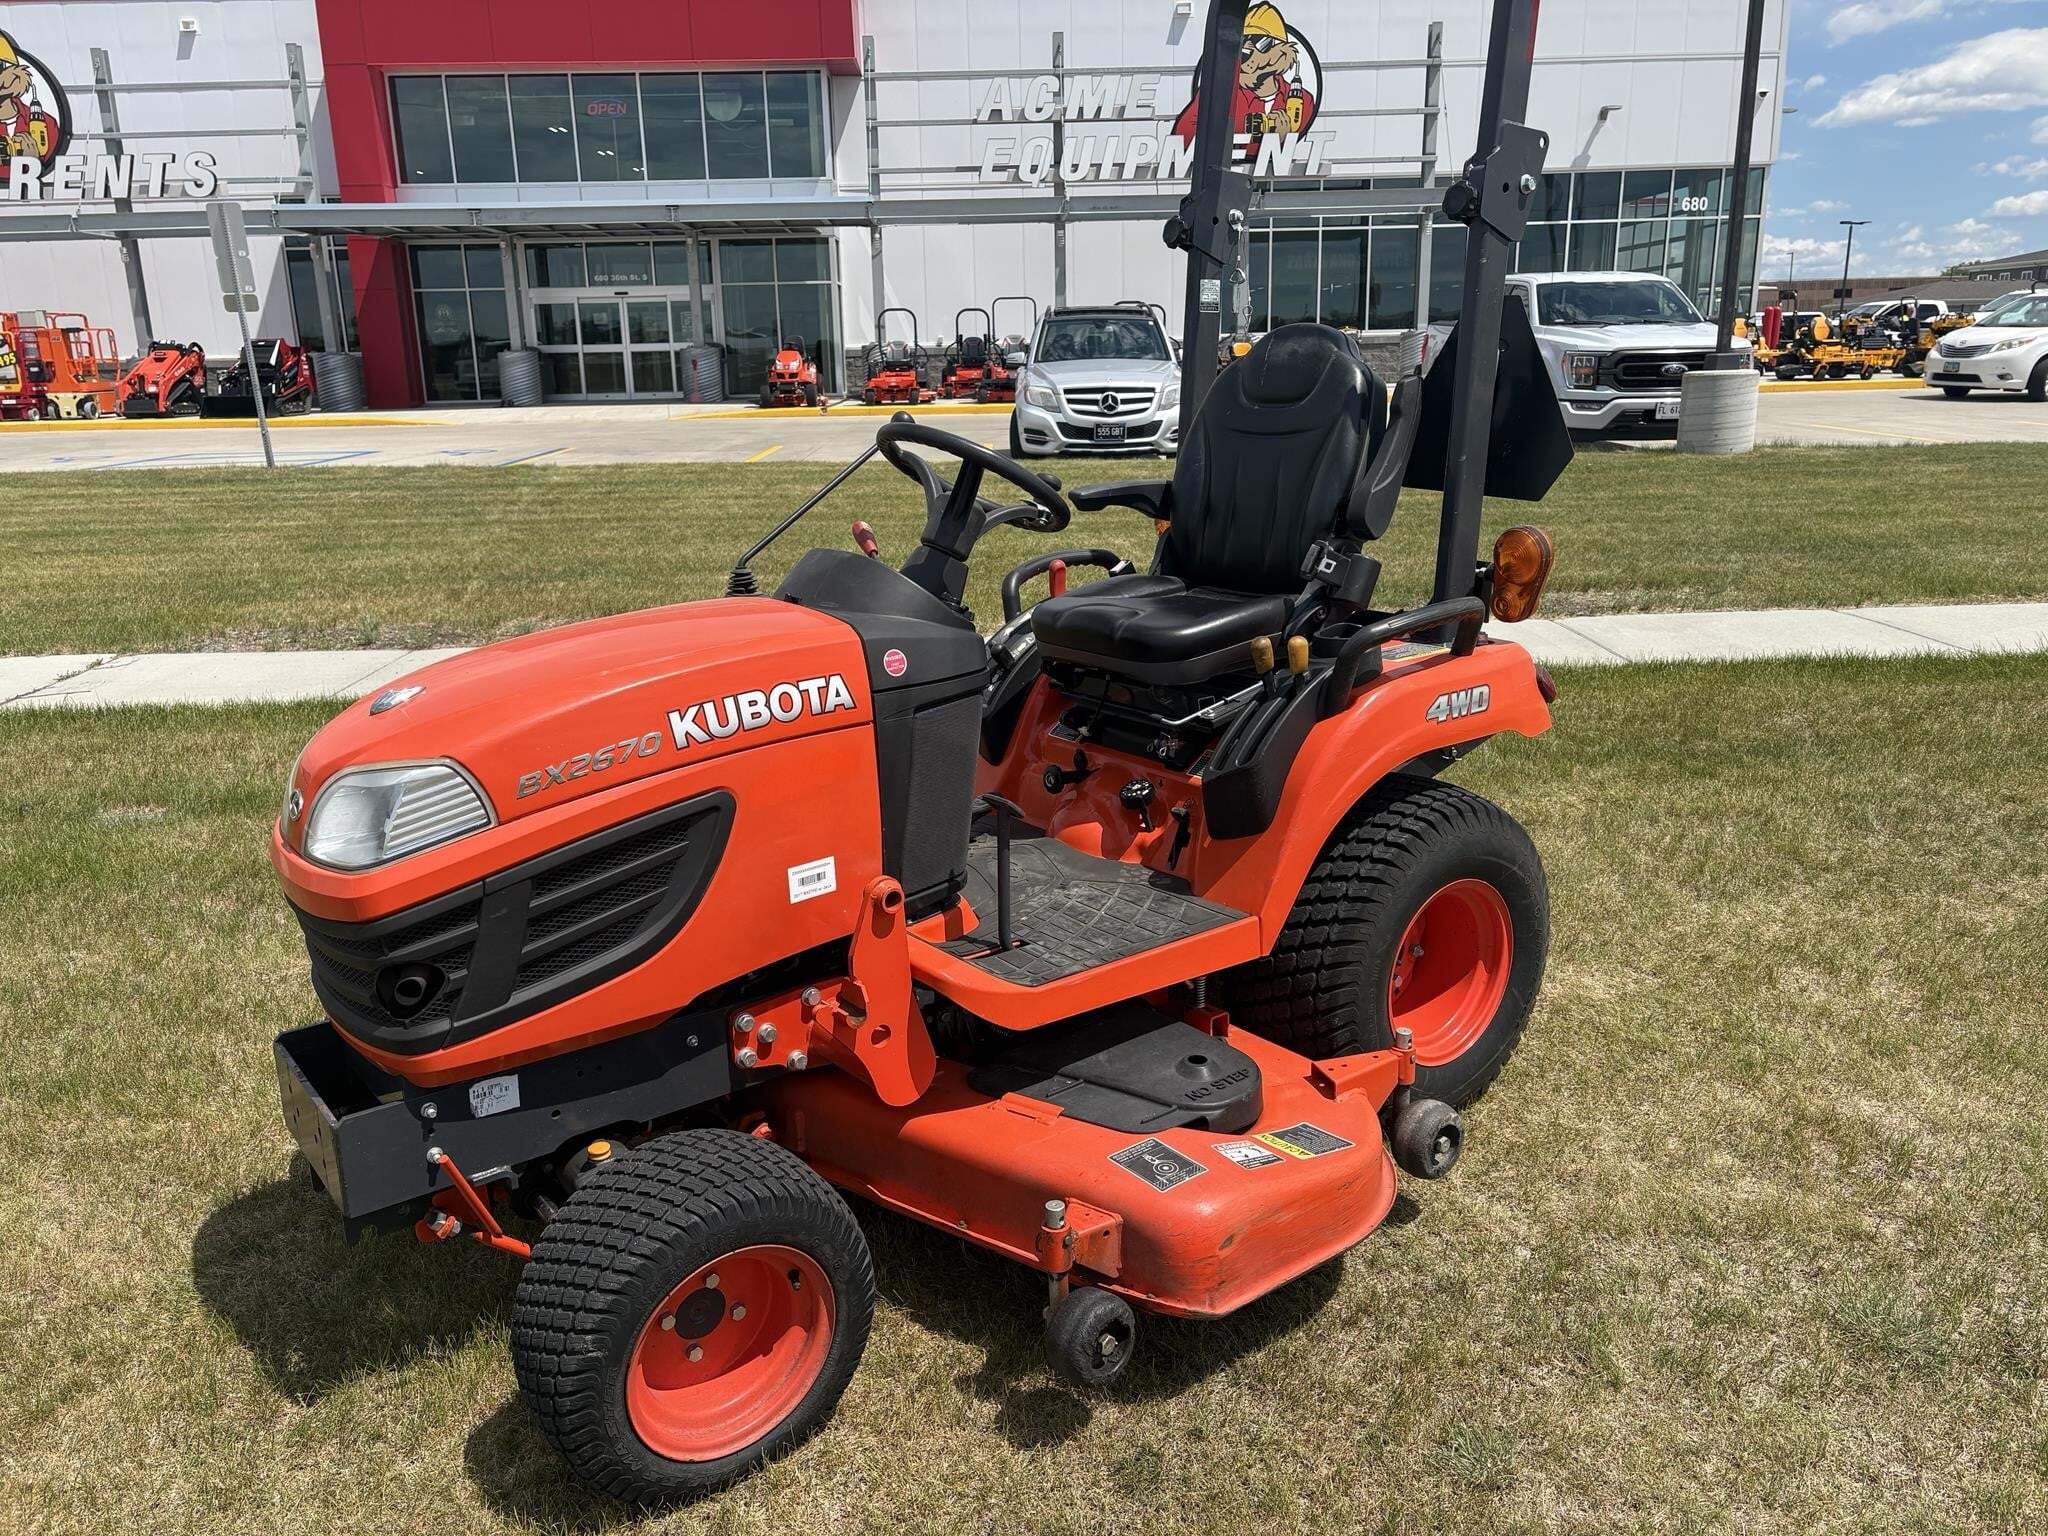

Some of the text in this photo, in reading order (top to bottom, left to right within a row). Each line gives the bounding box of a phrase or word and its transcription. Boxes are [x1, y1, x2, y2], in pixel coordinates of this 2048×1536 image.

[587, 103, 627, 115] OPEN
[977, 73, 1160, 121] ACME
[9, 151, 217, 200] RENTS
[1682, 196, 1709, 212] 680
[1097, 427, 1110, 436] 555
[667, 674, 857, 750] KUBOTA
[1425, 684, 1490, 724] 4WD
[516, 731, 663, 800] BX2670
[1184, 1068, 1250, 1102] NO STEP
